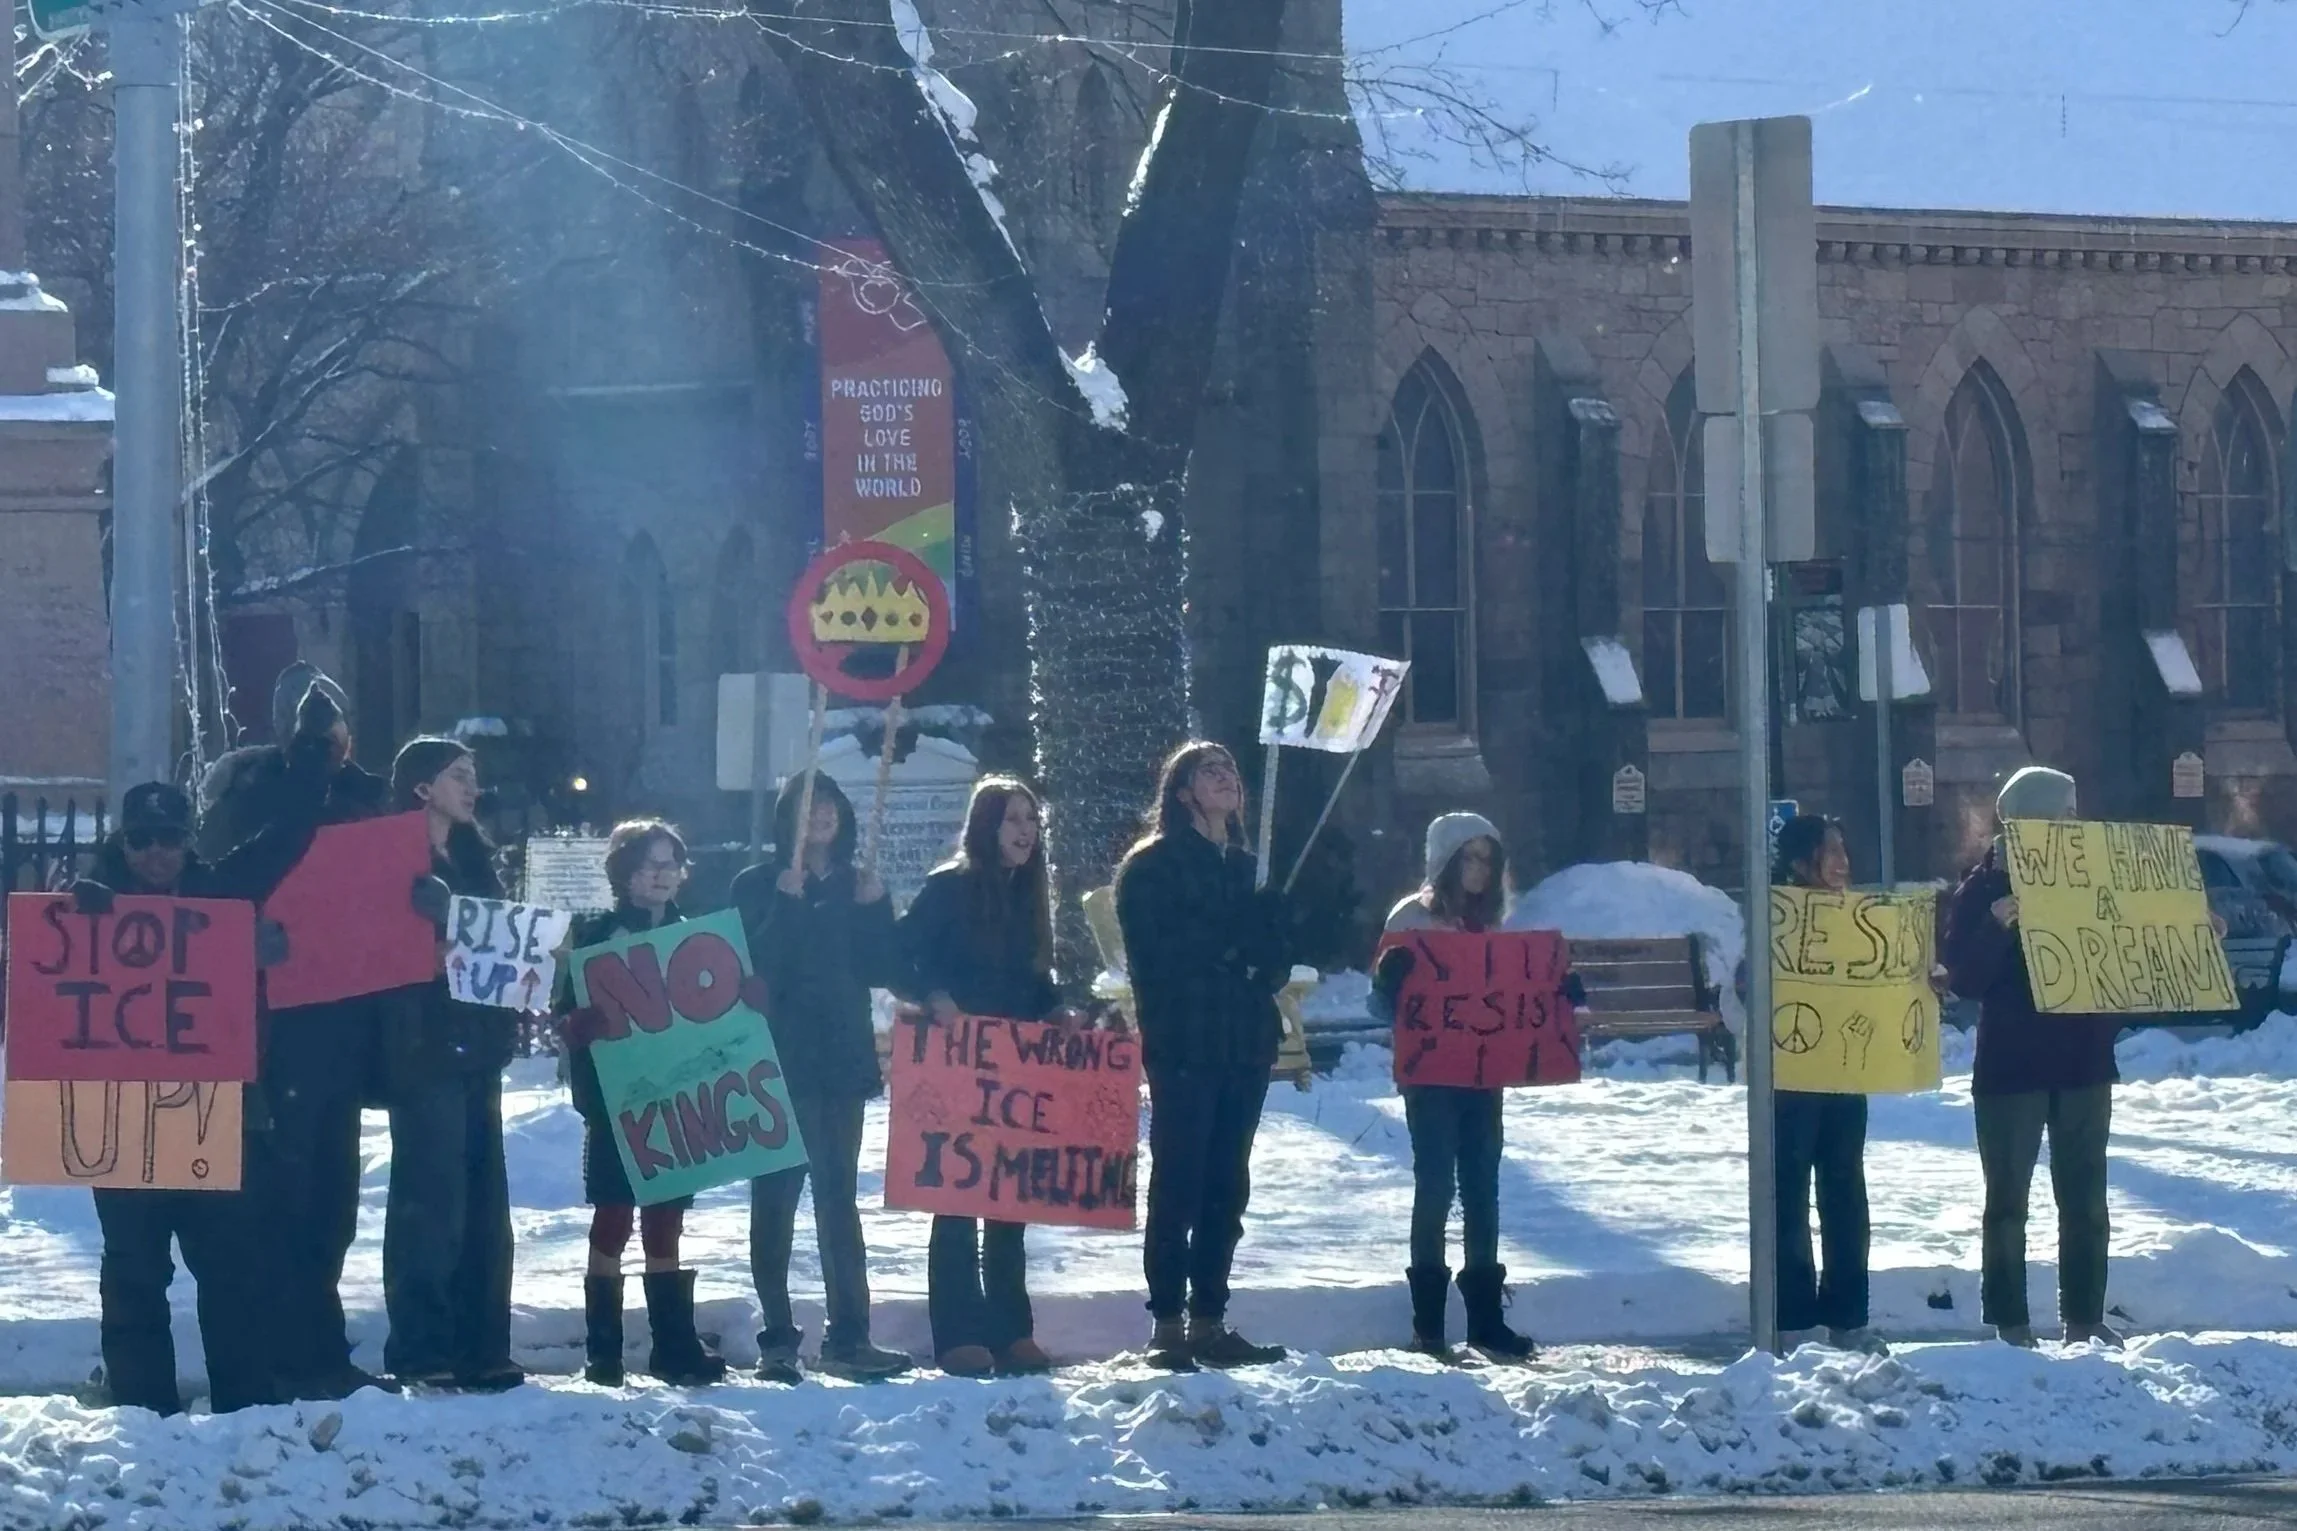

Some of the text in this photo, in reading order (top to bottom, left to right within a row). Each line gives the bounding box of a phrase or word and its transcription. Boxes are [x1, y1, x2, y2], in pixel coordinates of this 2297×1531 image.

[860, 404, 914, 422] GOD'S
[864, 429, 911, 447] LOVE
[855, 477, 922, 498] WORLD
[857, 453, 918, 472] IN THE
[2004, 821, 2203, 892] WE HAVE
[454, 898, 554, 964] RISE
[2096, 885, 2121, 922] A
[30, 901, 211, 975] STOP
[2026, 924, 2233, 1010] DREAM
[470, 962, 518, 1004] UP
[583, 932, 742, 1041] NO
[54, 979, 212, 1053] ICE
[902, 1015, 1136, 1071] THE WRONG
[60, 1080, 218, 1184] UP!
[618, 1060, 788, 1181] KINGS
[970, 1078, 1058, 1135] ICE
[914, 1131, 983, 1190] IS
